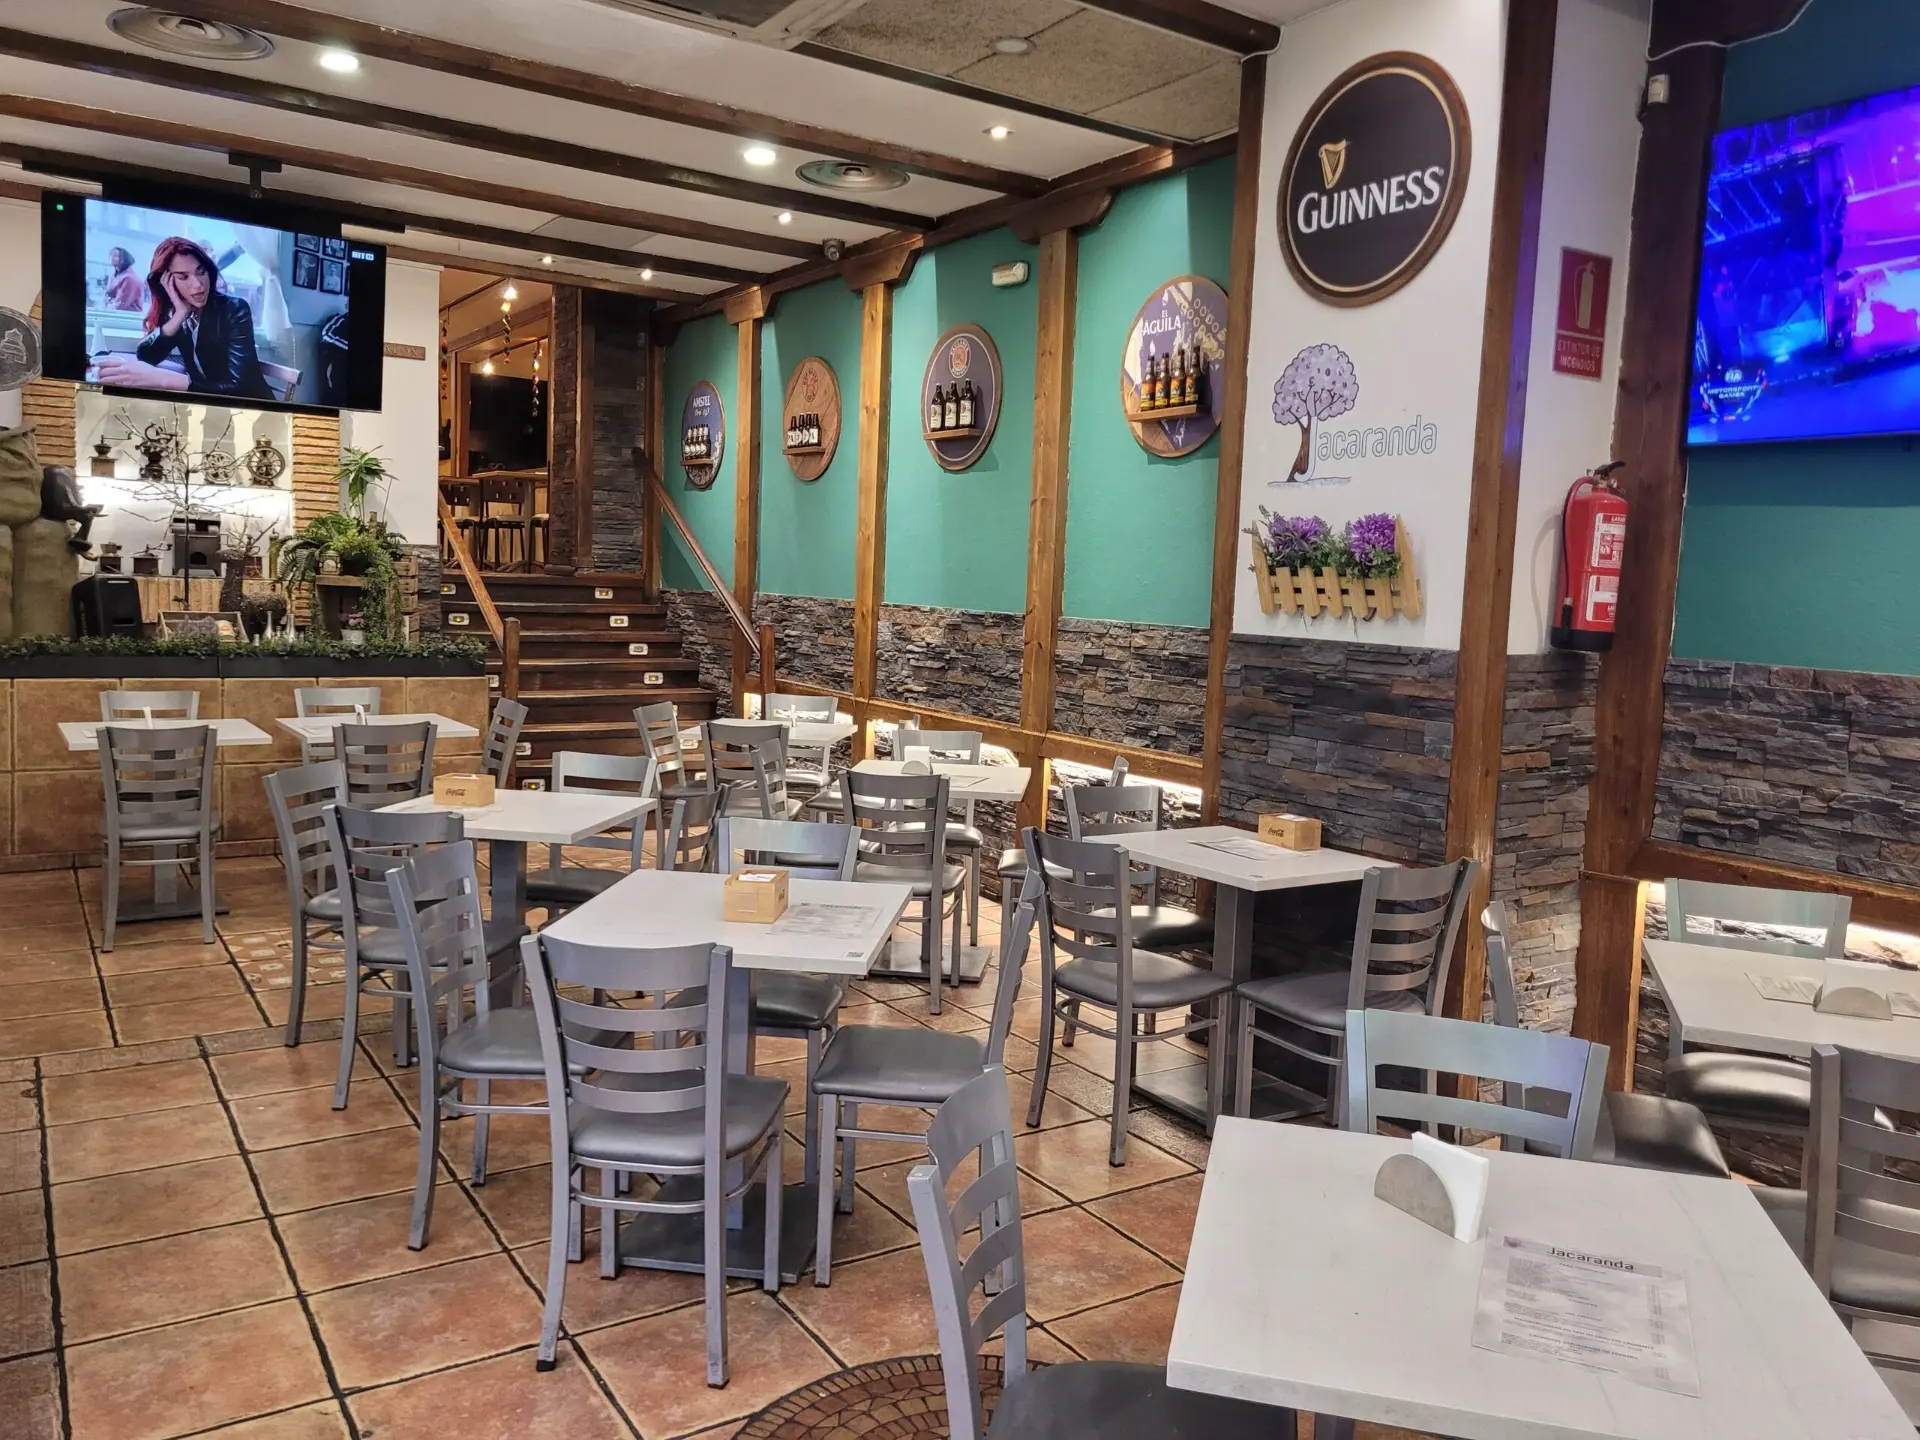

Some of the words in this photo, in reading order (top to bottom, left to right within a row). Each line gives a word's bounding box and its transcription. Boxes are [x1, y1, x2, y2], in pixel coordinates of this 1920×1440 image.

[1297, 165, 1442, 235] GUINNESS
[1162, 309, 1168, 318] EL
[1557, 339, 1590, 357] EXTINTOR
[1591, 345, 1601, 358] DE
[1559, 355, 1596, 372] INCENDIOS
[1725, 371, 1741, 382] FIA
[1707, 385, 1757, 395] MOTORSPORT
[693, 395, 711, 408] AMSTEL
[1293, 414, 1438, 483] Jacaranda
[1548, 1247, 1634, 1271] Jacaranda
